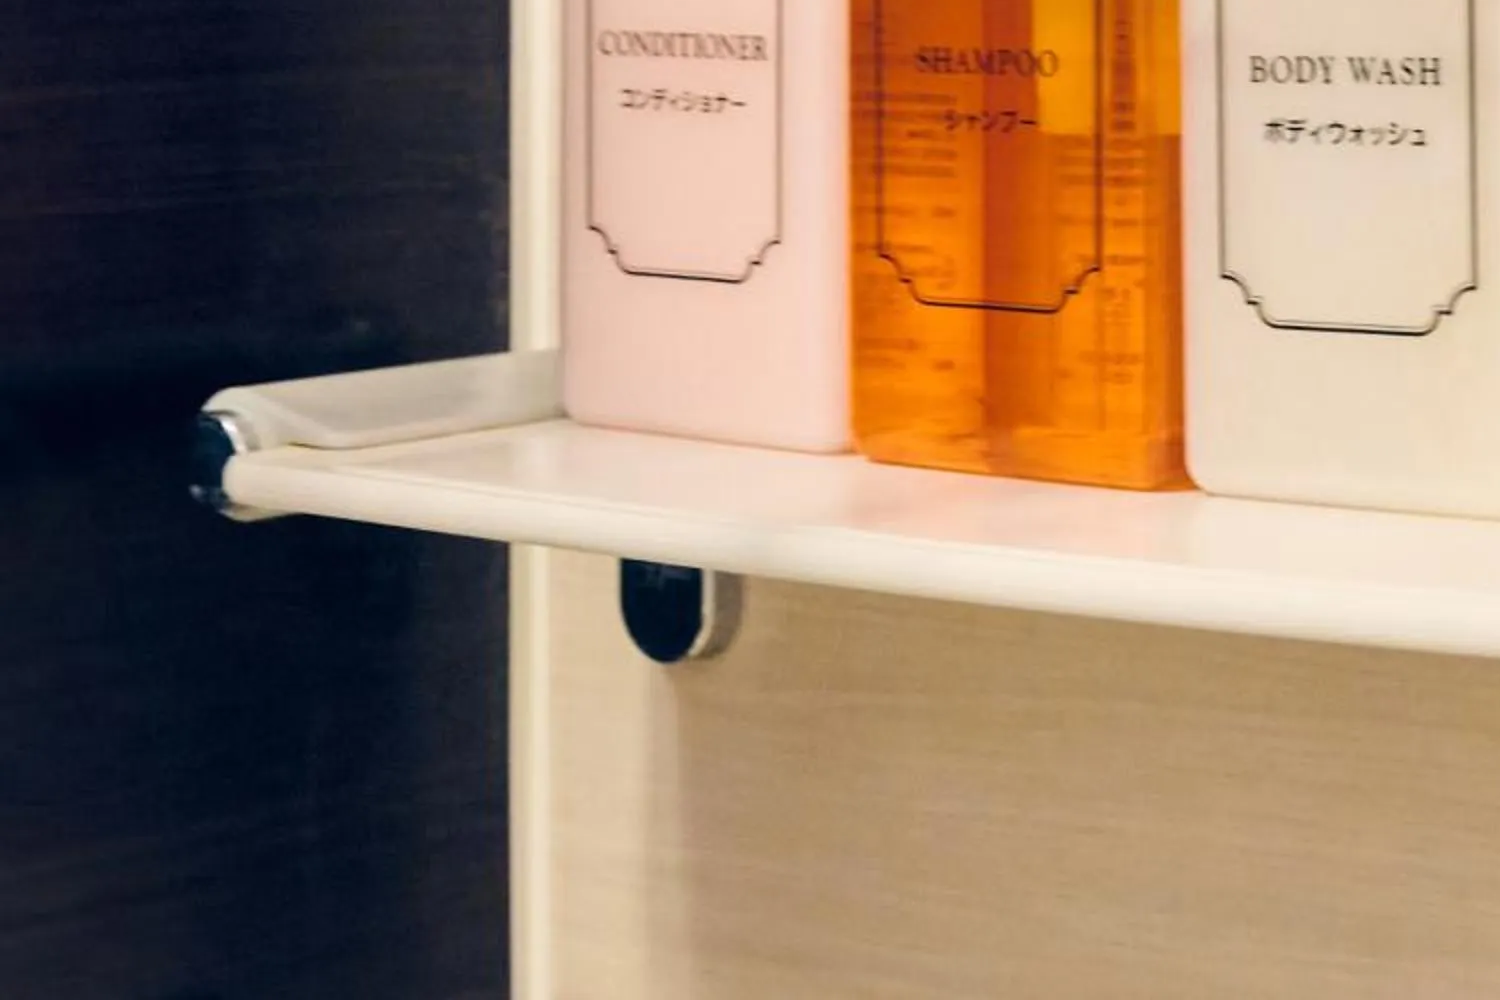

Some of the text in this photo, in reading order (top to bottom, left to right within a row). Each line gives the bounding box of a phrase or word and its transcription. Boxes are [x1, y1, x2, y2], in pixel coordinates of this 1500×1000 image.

[599, 29, 768, 62] CONDITIONER
[915, 46, 1059, 77] SHAMPOO
[1249, 55, 1441, 86] BODY WASH
